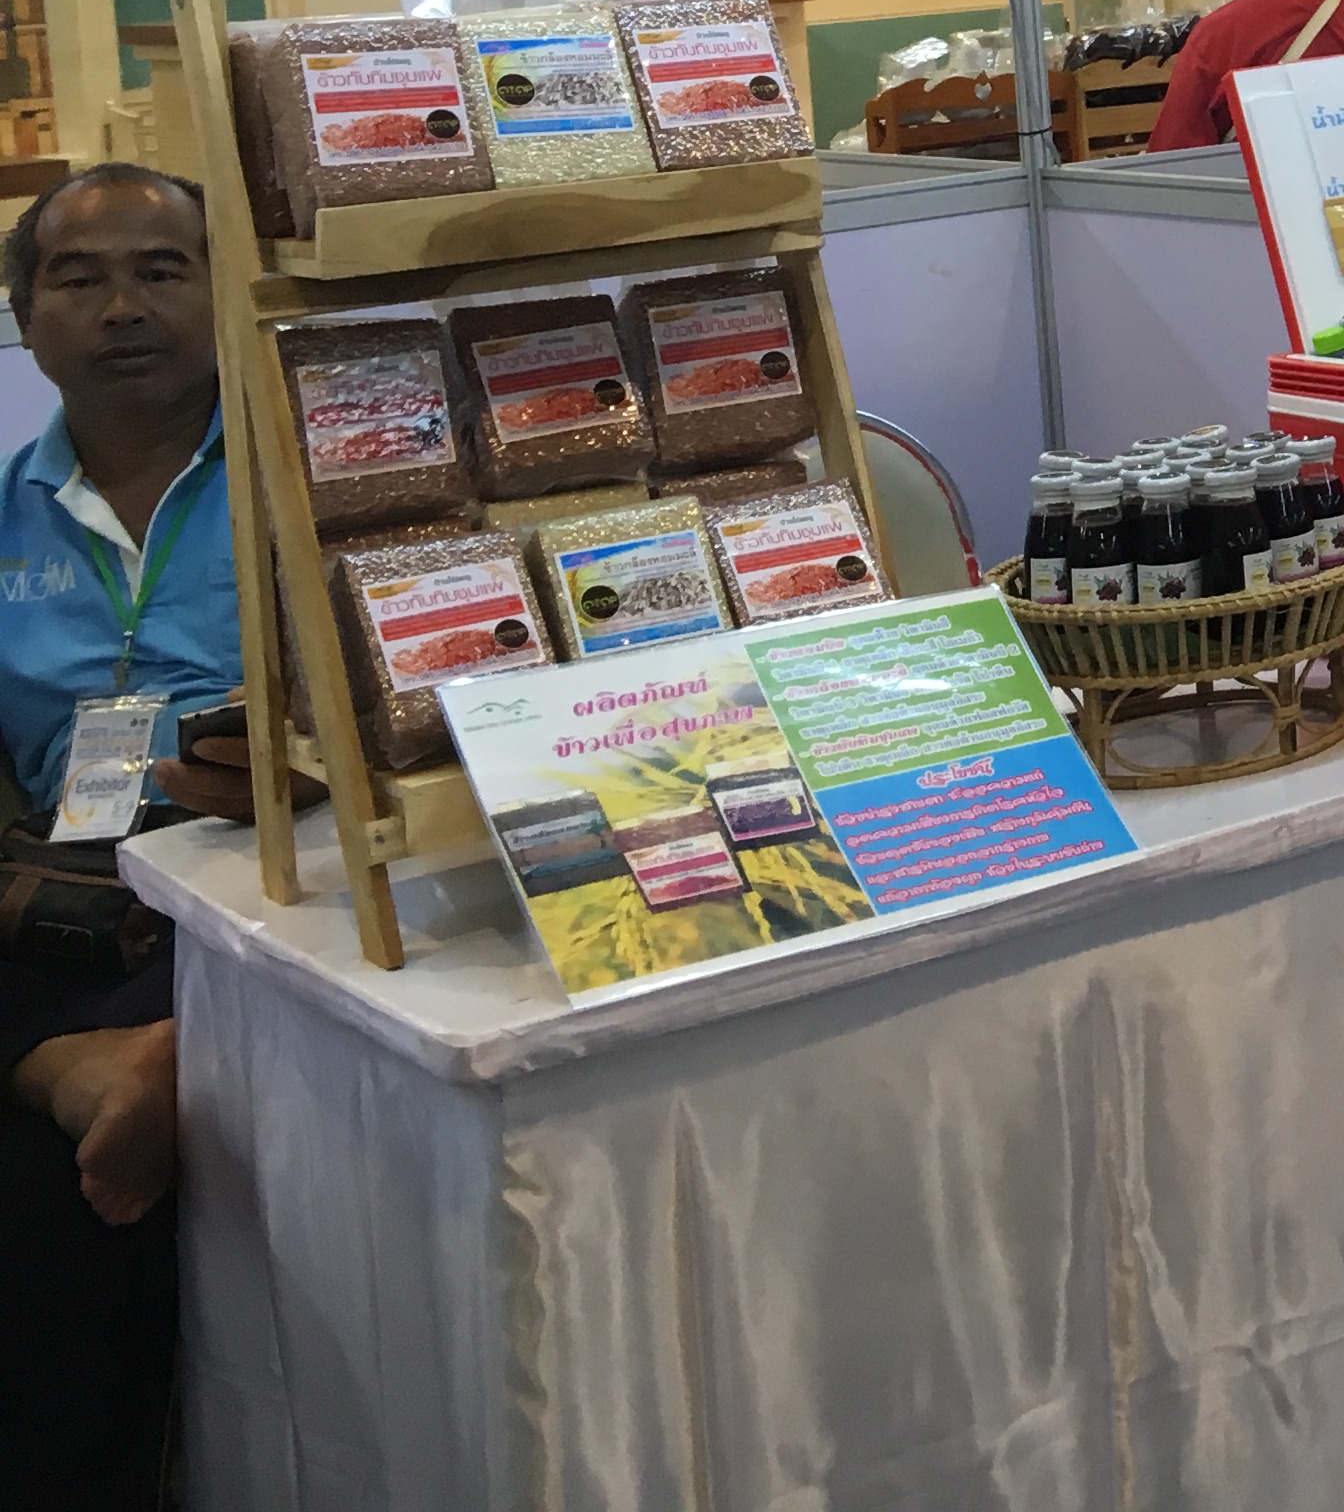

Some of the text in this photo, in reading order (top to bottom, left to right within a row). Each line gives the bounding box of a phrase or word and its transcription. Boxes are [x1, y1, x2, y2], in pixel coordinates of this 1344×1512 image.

[648, 39, 759, 60] ข้าวทับทิมชุมแพ
[317, 68, 442, 88] ข้าวทับทิมชุมแพ
[662, 313, 774, 339] ข้าวทับทิมชุมแพ
[733, 520, 843, 551] ข้าวทับทิมชุมแพ
[380, 579, 504, 616] ข้าวทับทิมชุมแพ
[573, 669, 708, 717] ผลิตภัณฑ์
[75, 777, 131, 795] Exhibitor
[917, 756, 994, 788] ประโยชน์
